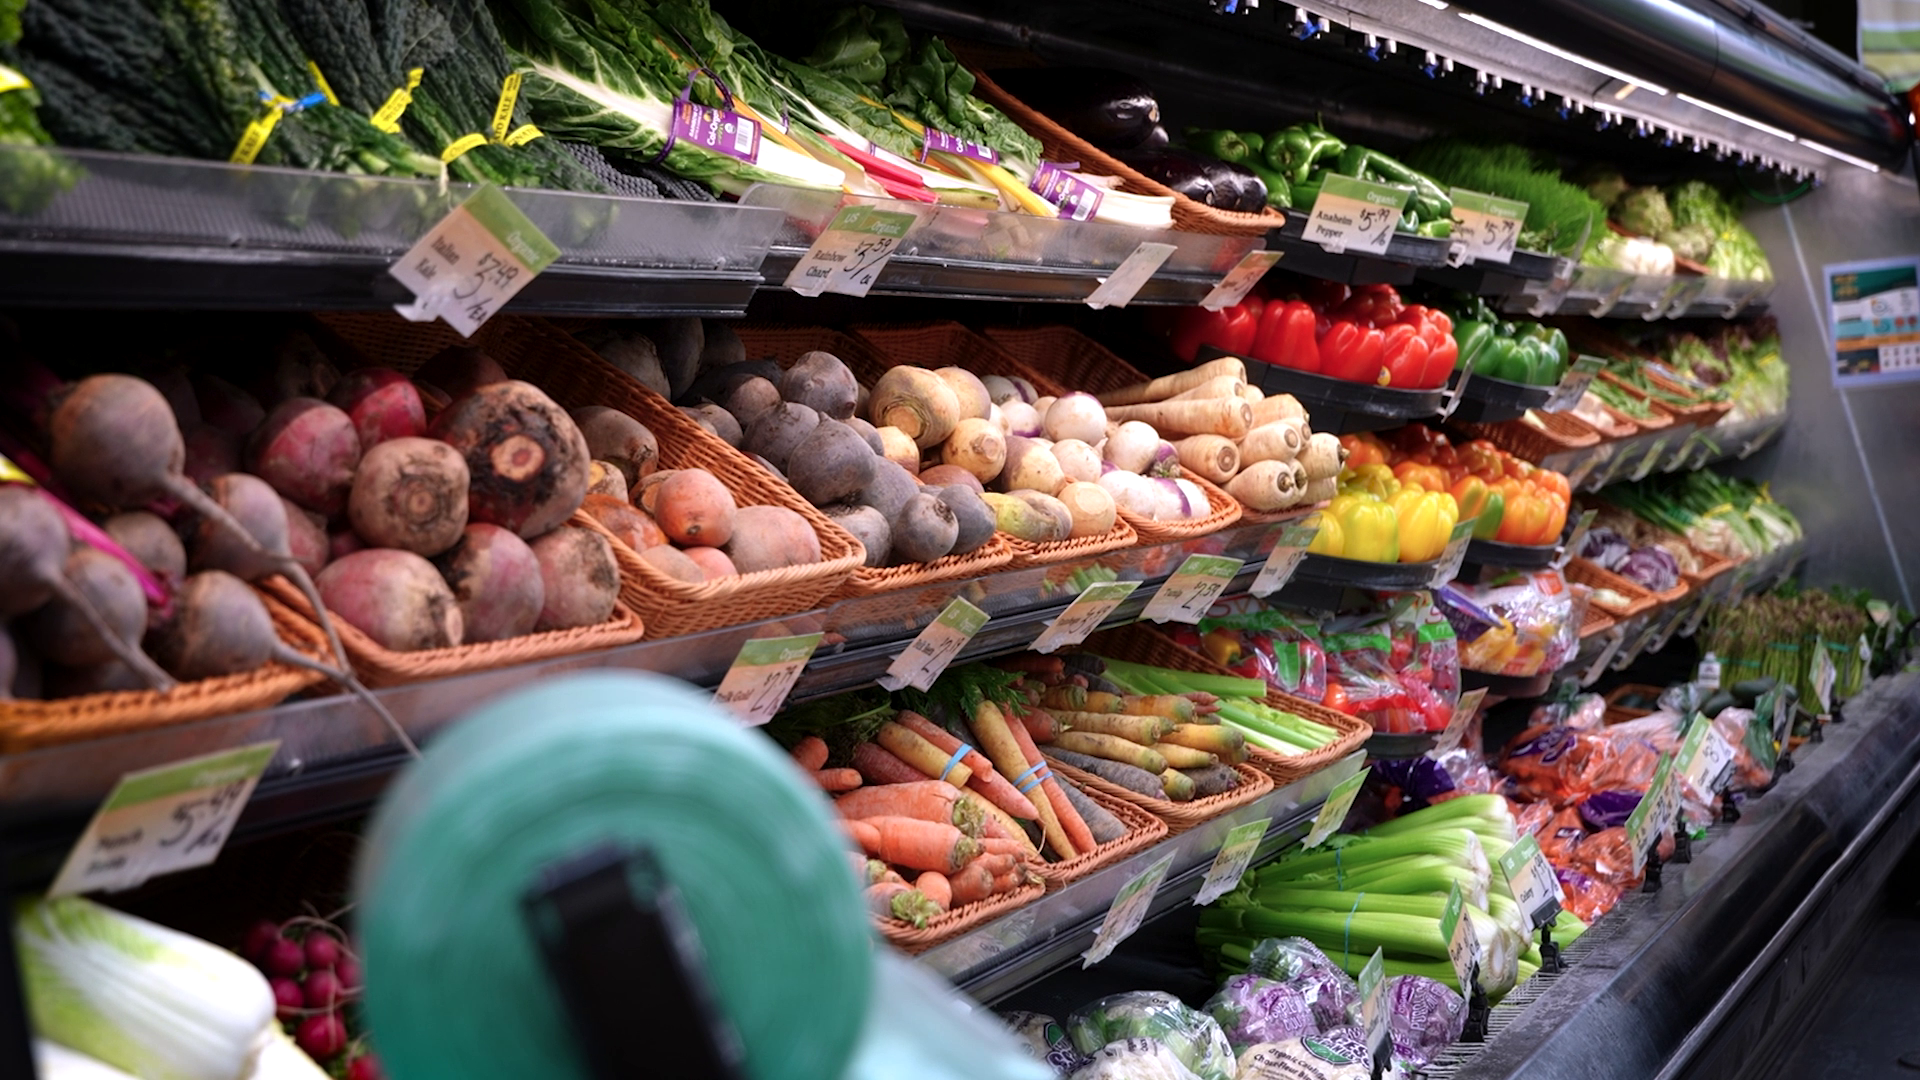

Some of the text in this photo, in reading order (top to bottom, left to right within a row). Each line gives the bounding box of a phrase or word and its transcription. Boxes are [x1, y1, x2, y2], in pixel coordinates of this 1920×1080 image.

[1367, 191, 1398, 206] Organic
[1316, 210, 1353, 226] Anaheim
[1358, 208, 1391, 232] $5.99
[870, 220, 901, 235] Organic
[1316, 224, 1344, 239] Pepper
[431, 235, 461, 266] Italian
[506, 230, 541, 266] Organic
[812, 249, 848, 262] Rainbow
[414, 257, 438, 281] Kale
[806, 266, 832, 279] Chard
[779, 645, 810, 662] Organic
[1519, 887, 1535, 904] Celery
